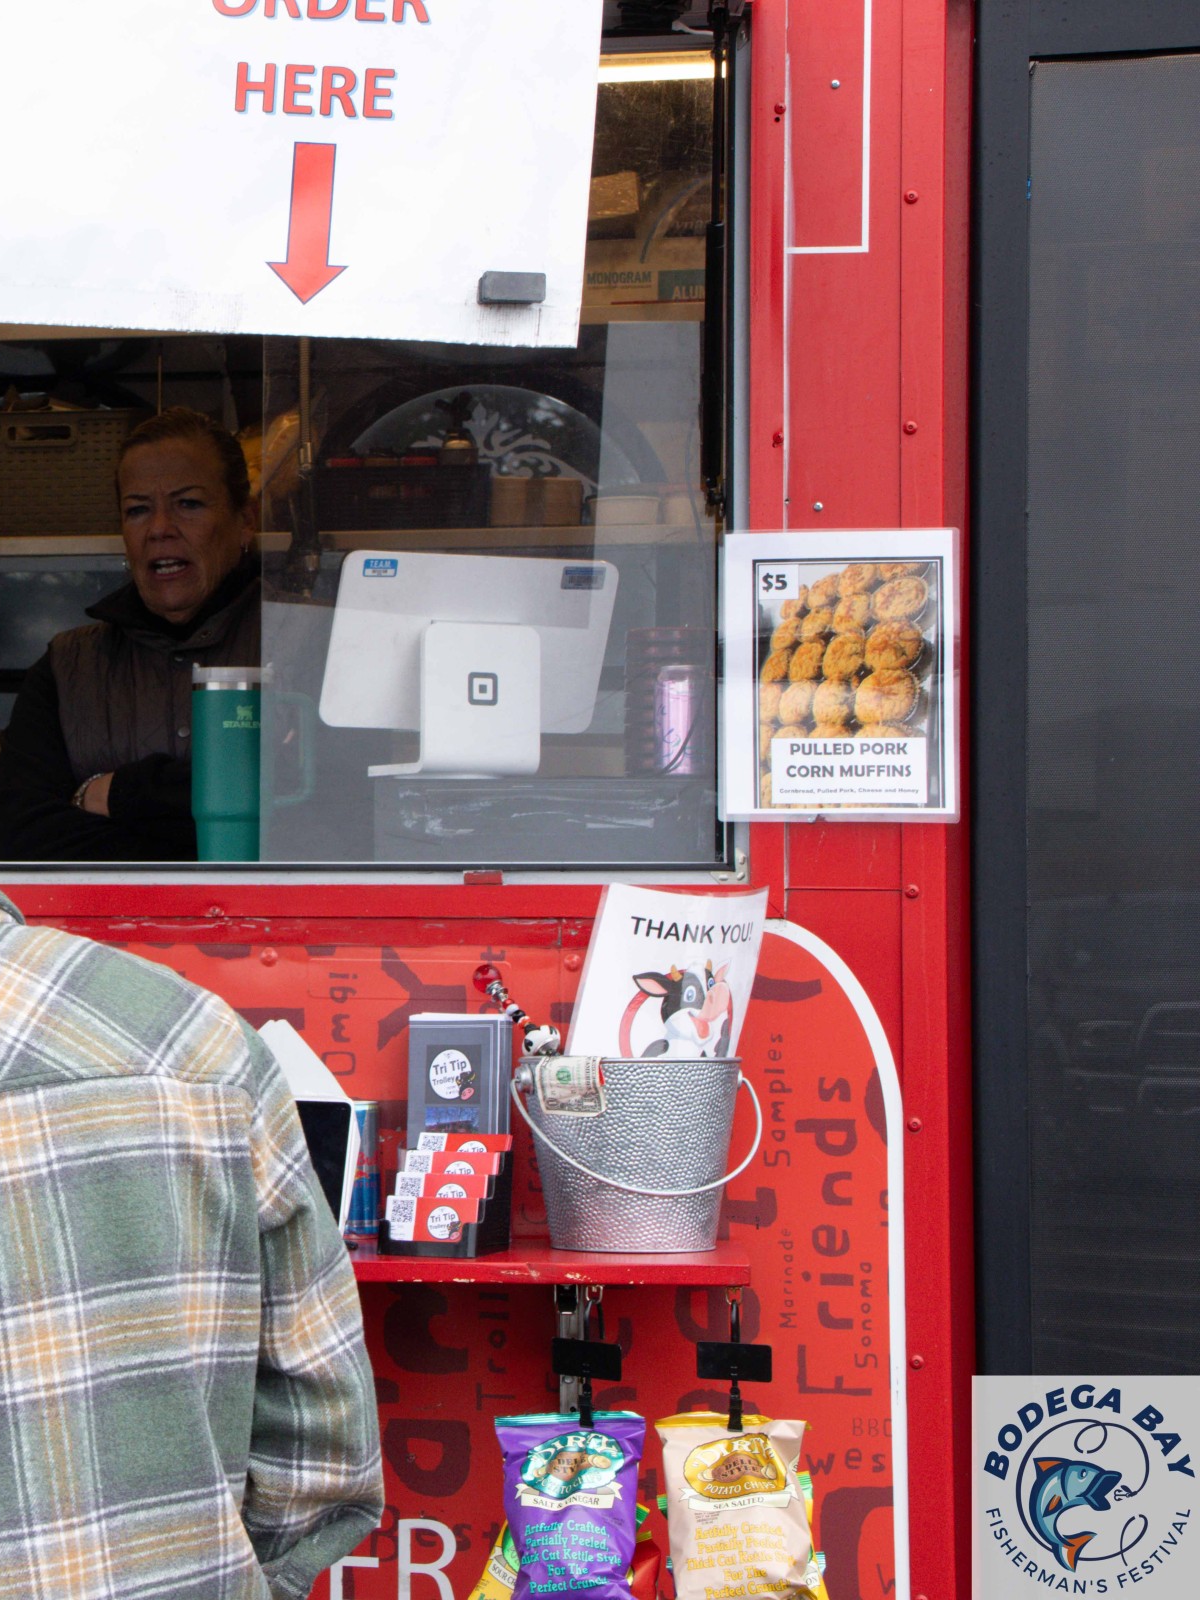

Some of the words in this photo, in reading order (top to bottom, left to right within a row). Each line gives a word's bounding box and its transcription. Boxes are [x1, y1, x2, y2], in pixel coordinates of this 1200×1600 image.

[235, 61, 397, 120] HERE
[762, 572, 788, 592] $5
[790, 742, 855, 756] PULLED
[860, 742, 908, 755] PORK
[786, 765, 835, 778] CORN
[840, 764, 912, 778] MUFFINS
[631, 916, 715, 943] THANK
[720, 922, 753, 944] YOU!
[432, 1062, 447, 1075] Tri
[449, 1060, 467, 1072] Tip
[763, 1032, 793, 1168] Samples
[430, 1214, 441, 1223] Tri
[443, 1212, 456, 1221] Tip
[794, 1075, 873, 1396] Friends
[777, 1228, 797, 1329] Marinade
[854, 1261, 878, 1369] Sonoma
[476, 1292, 514, 1411] Troll
[721, 1465, 760, 1479] STYLE
[724, 1458, 752, 1471] DELI
[704, 1483, 742, 1495] POTATO
[743, 1480, 776, 1490] CHIPS
[533, 1498, 555, 1508] SALT
[556, 1501, 563, 1509] &
[564, 1494, 600, 1505] VINEGAR
[712, 1502, 730, 1510] SEA
[731, 1496, 765, 1508] SALTED
[567, 1519, 610, 1538] Crafted,
[695, 1524, 739, 1540] Artfully
[526, 1534, 568, 1551] Partially
[571, 1534, 609, 1552] Peeled,
[697, 1537, 744, 1554] Partially
[541, 1549, 560, 1561] Cut
[563, 1548, 594, 1562] Kettle
[686, 1556, 715, 1571] Thick
[717, 1553, 737, 1567] Cut
[547, 1563, 566, 1577] For
[568, 1562, 589, 1575] The
[723, 1568, 743, 1582] For
[744, 1565, 768, 1579] The
[529, 1580, 568, 1594] Perfect
[704, 1584, 747, 1600] Perfect
